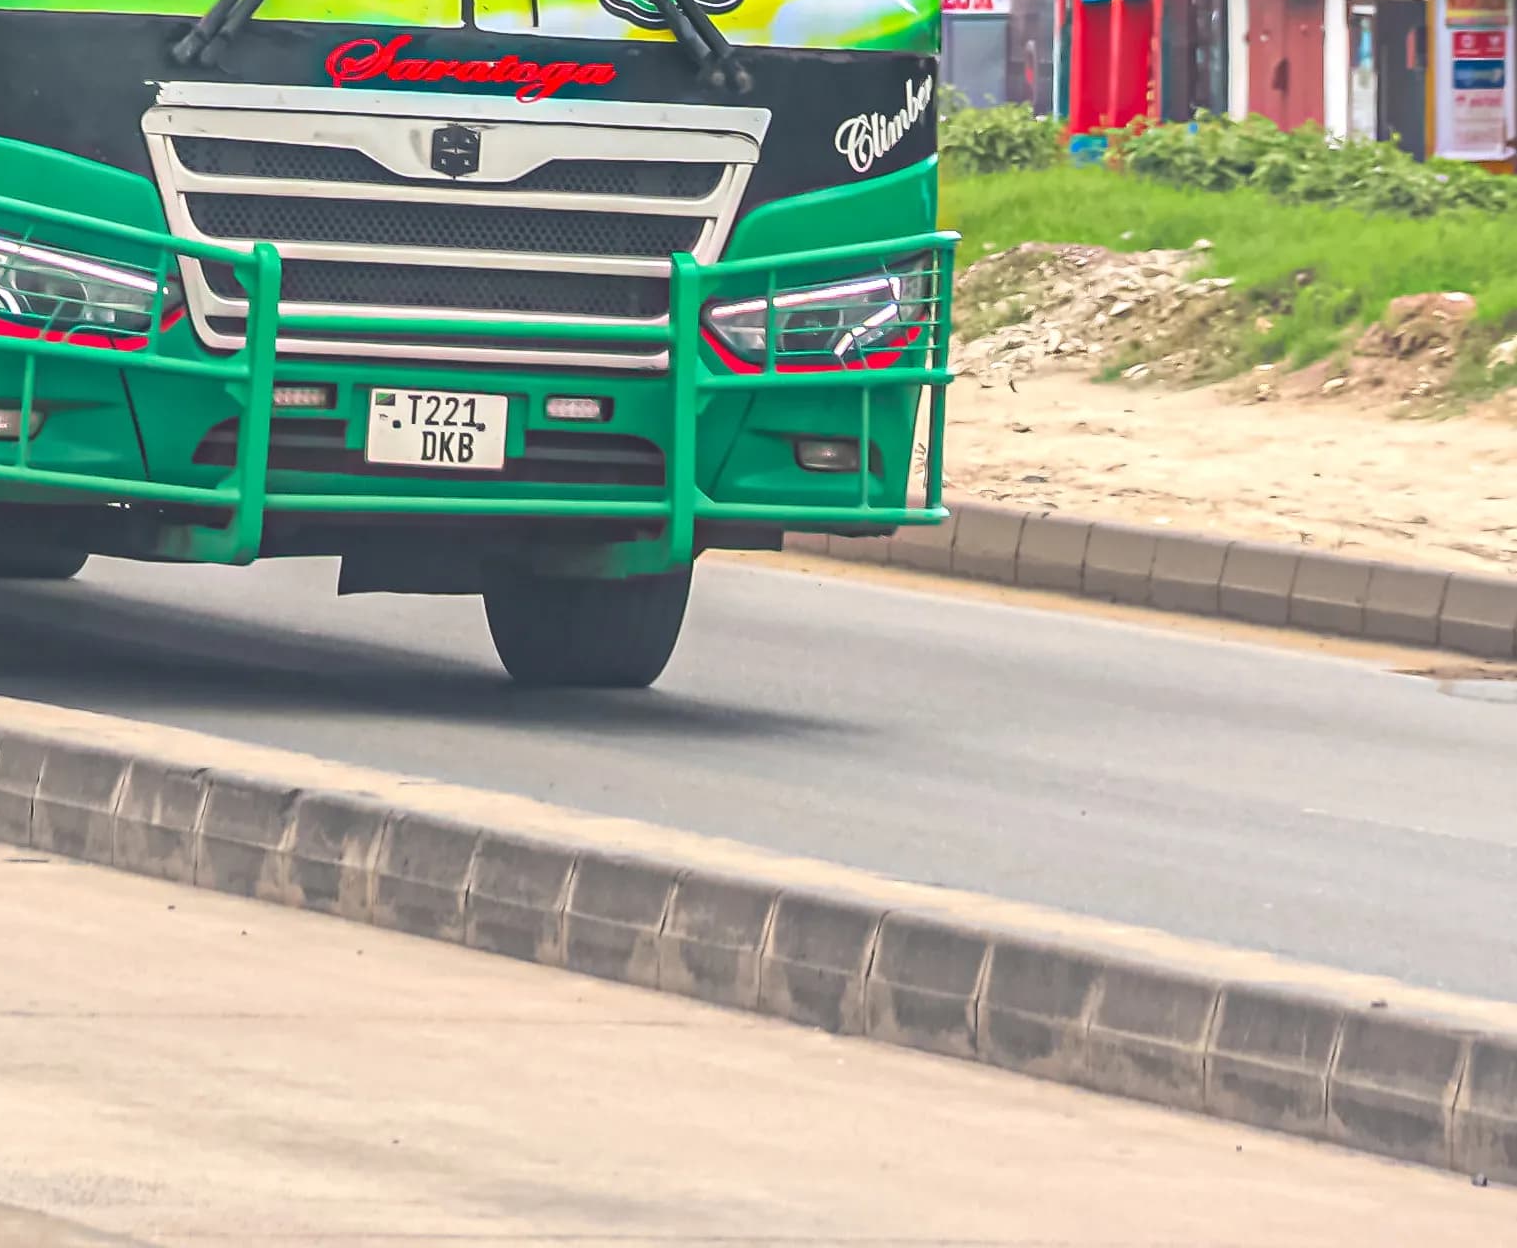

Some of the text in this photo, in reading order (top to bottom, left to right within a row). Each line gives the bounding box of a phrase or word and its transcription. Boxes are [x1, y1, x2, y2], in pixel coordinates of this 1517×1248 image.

[325, 34, 617, 104] Saratoga
[408, 394, 477, 429] T221
[420, 430, 475, 463] DKB
